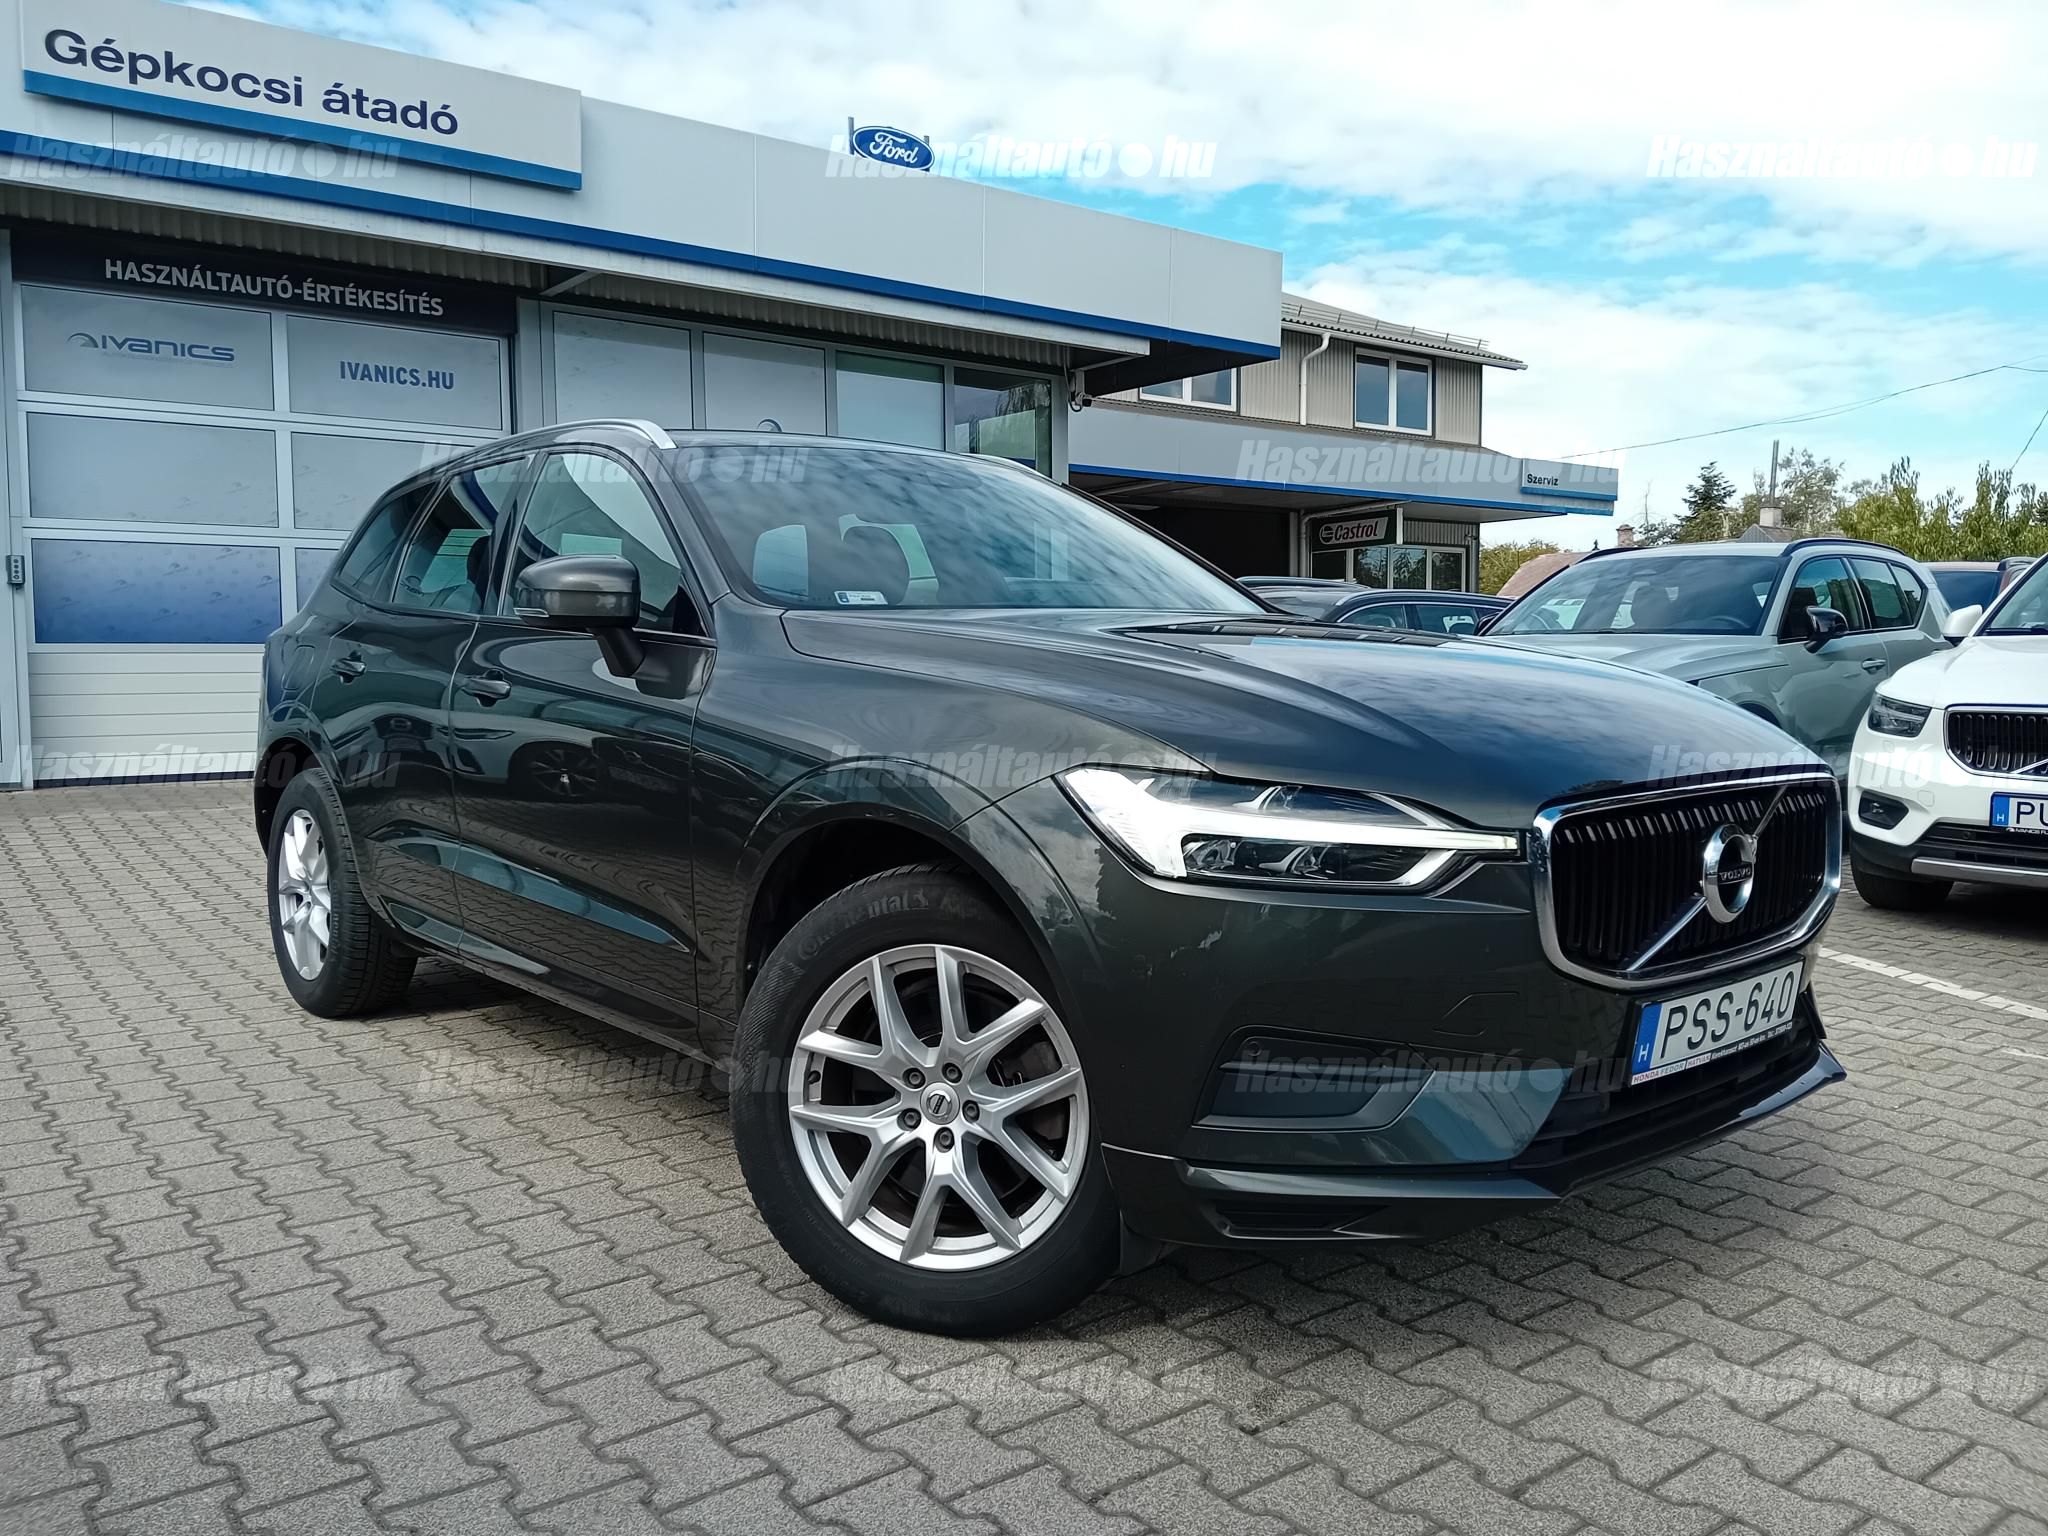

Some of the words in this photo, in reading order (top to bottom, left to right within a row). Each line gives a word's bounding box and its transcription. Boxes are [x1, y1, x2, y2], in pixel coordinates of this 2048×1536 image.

[44, 28, 303, 107] Gépkocsi
[322, 82, 459, 135] átadó
[869, 132, 918, 163] Ford
[105, 258, 444, 317] HASZNÁLTAUTÓ-ÉRTÉKESÍTÉS
[340, 361, 454, 390] IVANICS.HU
[1527, 473, 1559, 486] Szerviz
[1334, 520, 1379, 541] Castrol
[1719, 866, 1751, 881] VOLVO
[1637, 1042, 1650, 1063] H
[1660, 970, 1795, 1059] PSS-640
[1633, 1069, 1660, 1084] HONDA
[1660, 1062, 1685, 1075] FEDOR
